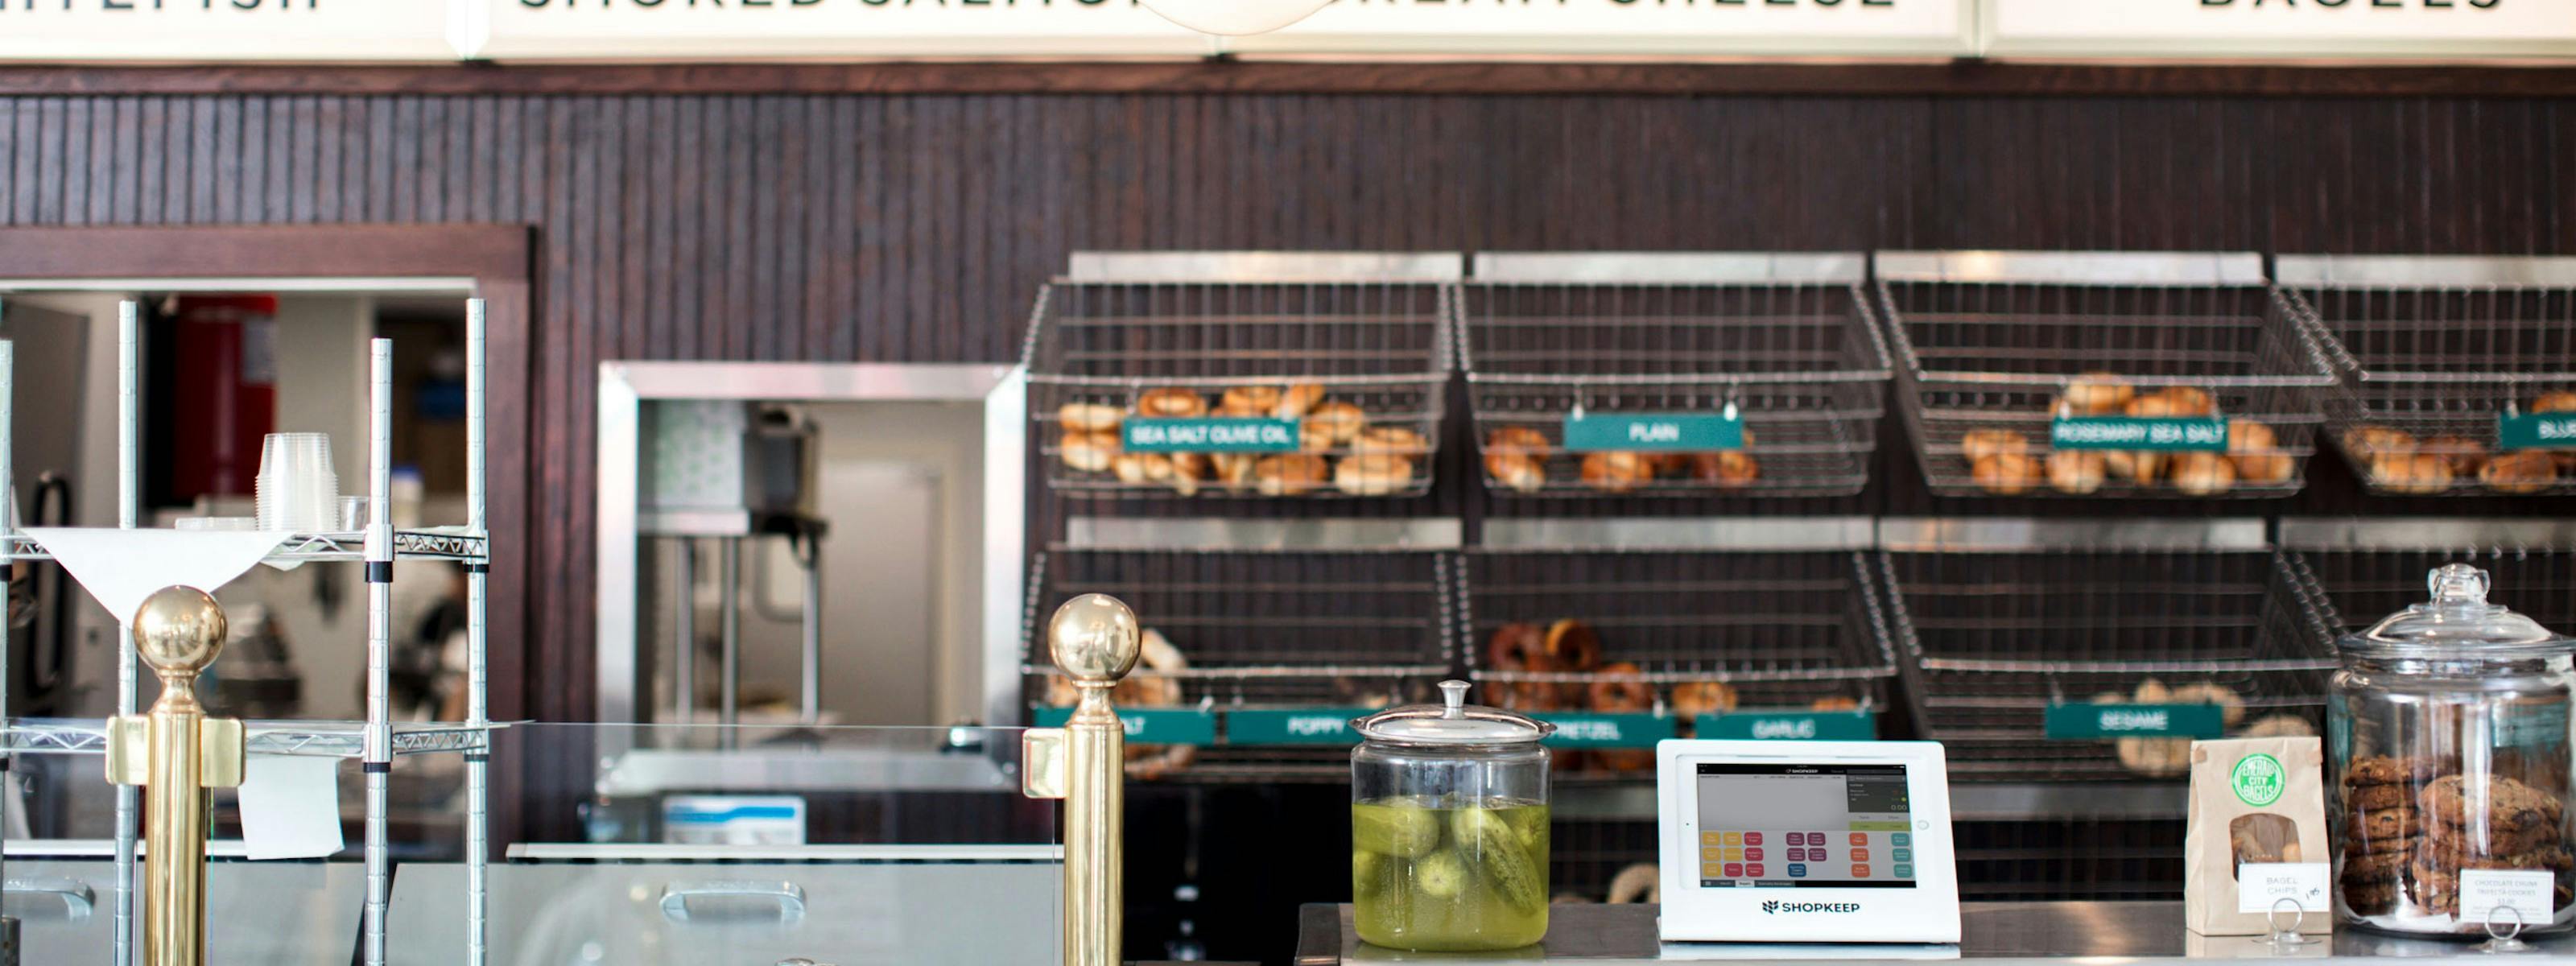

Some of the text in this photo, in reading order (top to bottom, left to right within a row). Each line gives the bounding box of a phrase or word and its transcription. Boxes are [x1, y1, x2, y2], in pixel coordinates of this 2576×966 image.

[1131, 425, 1291, 444] SEA SALT OLIVE OIL
[1629, 423, 1680, 442] PLAIN
[2056, 423, 2224, 444] ROSEMARY SEA SALT
[1288, 716, 1345, 736] POPPY
[1550, 718, 1622, 740] RETZEL
[1752, 719, 1815, 739] GARLIC
[2100, 709, 2168, 730] SESAME
[2241, 759, 2276, 777] EMERALD
[2248, 776, 2268, 786] CITY
[2243, 784, 2275, 800] BAGELS
[2268, 886, 2297, 895] CHIPS
[1782, 902, 1860, 913] SHOPKEEP
